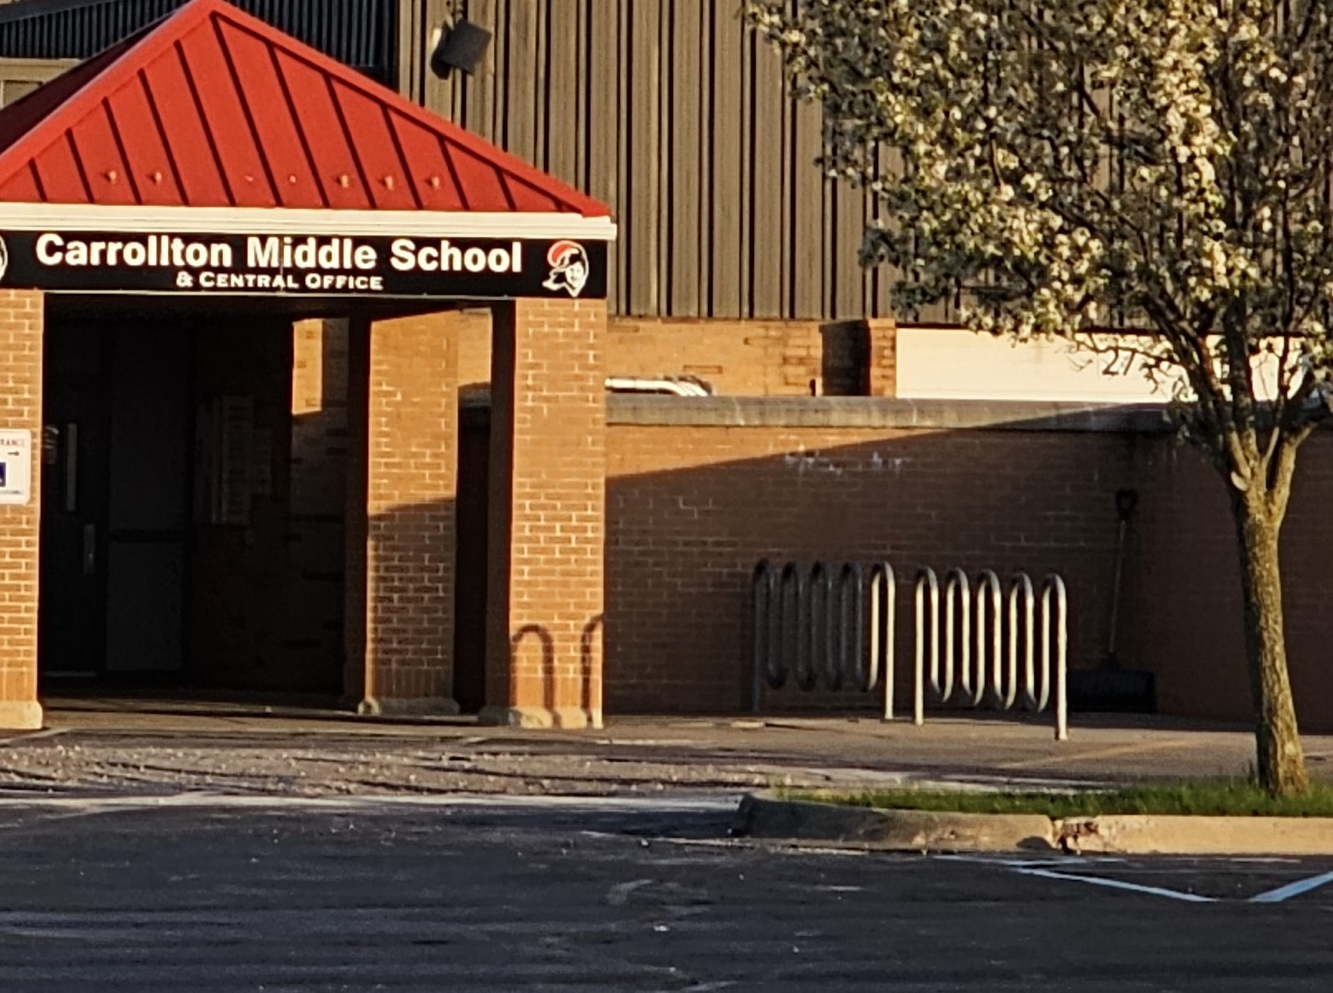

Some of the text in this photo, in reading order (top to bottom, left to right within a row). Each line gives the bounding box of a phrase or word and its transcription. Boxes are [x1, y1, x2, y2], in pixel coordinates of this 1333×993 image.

[35, 232, 523, 273] Carrollton Middle School
[176, 270, 384, 291] & CENTRAL OFFICE
